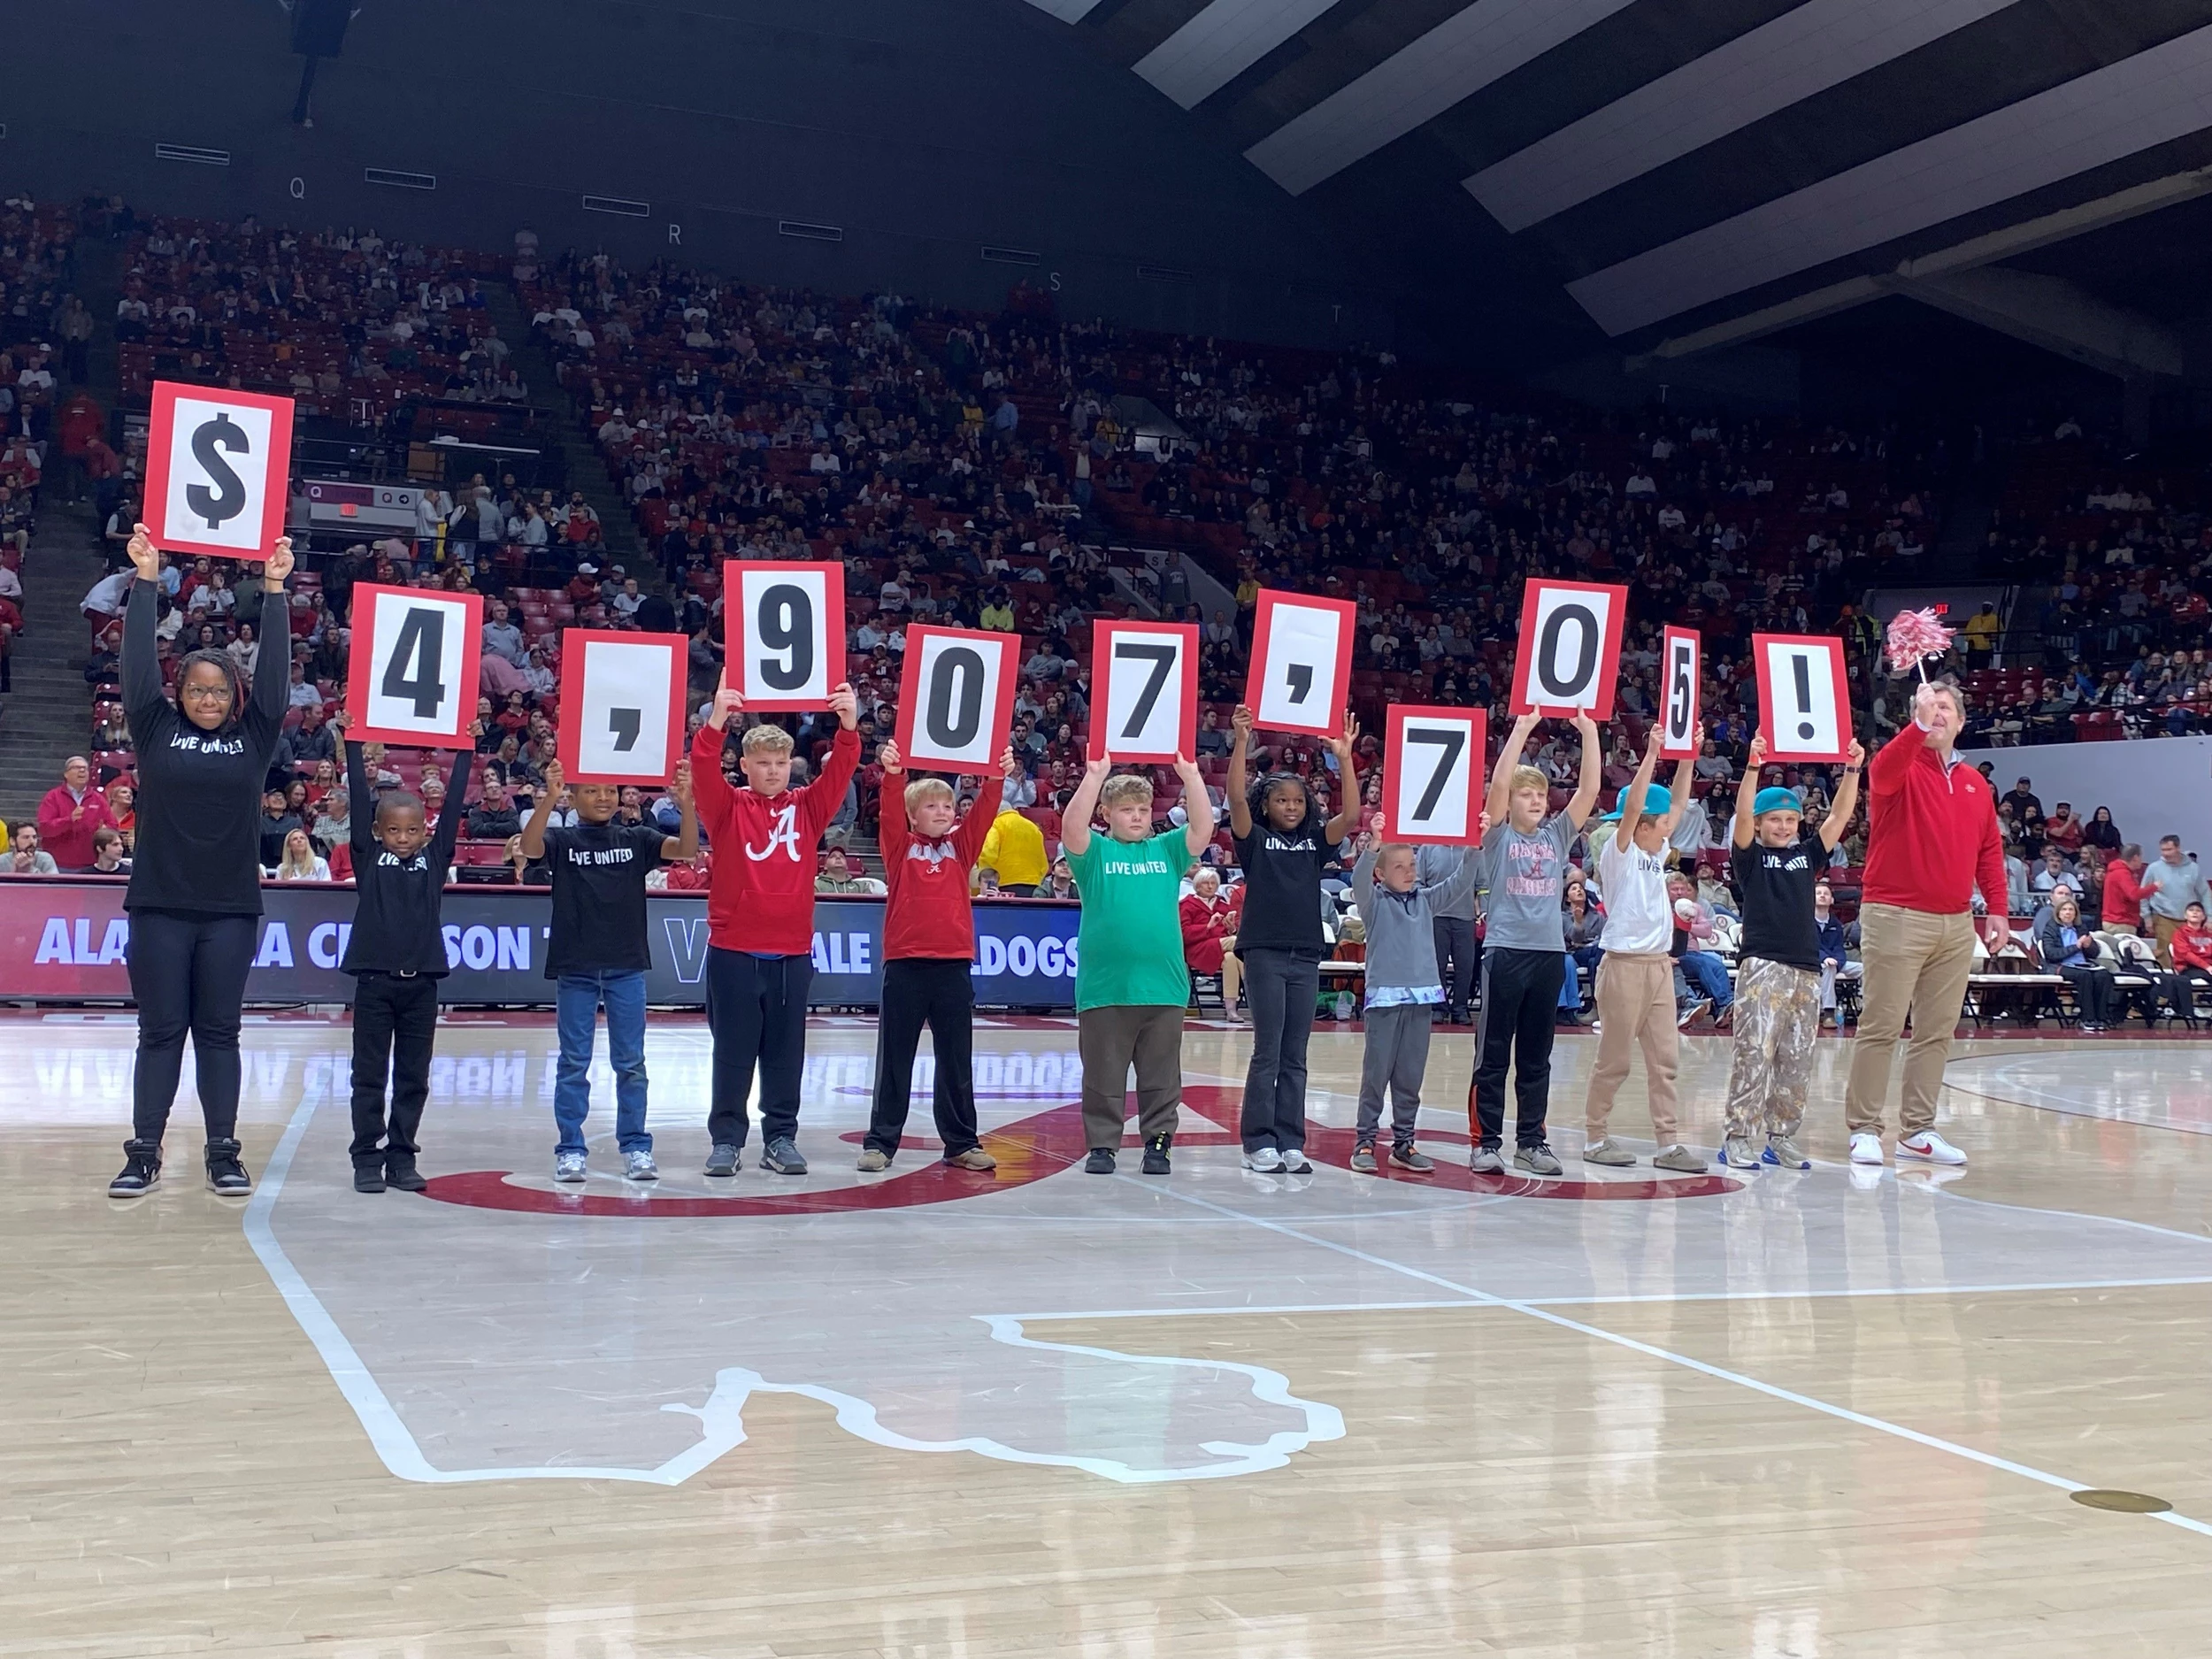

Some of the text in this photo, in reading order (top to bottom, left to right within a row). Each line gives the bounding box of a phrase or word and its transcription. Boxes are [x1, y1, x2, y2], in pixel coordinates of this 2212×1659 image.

[290, 177, 304, 199] Q
[669, 223, 681, 245] R
[1050, 272, 1061, 291] S
[1332, 304, 1341, 323] T
[311, 486, 322, 498] Q
[186, 412, 1815, 821] $ 4 , 9 0 7 , 7 0 5 !
[377, 851, 401, 866] LVE
[568, 848, 634, 866] LVE UNITED
[1105, 860, 1168, 875] LIVE UNITED
[811, 933, 872, 974] ALE
